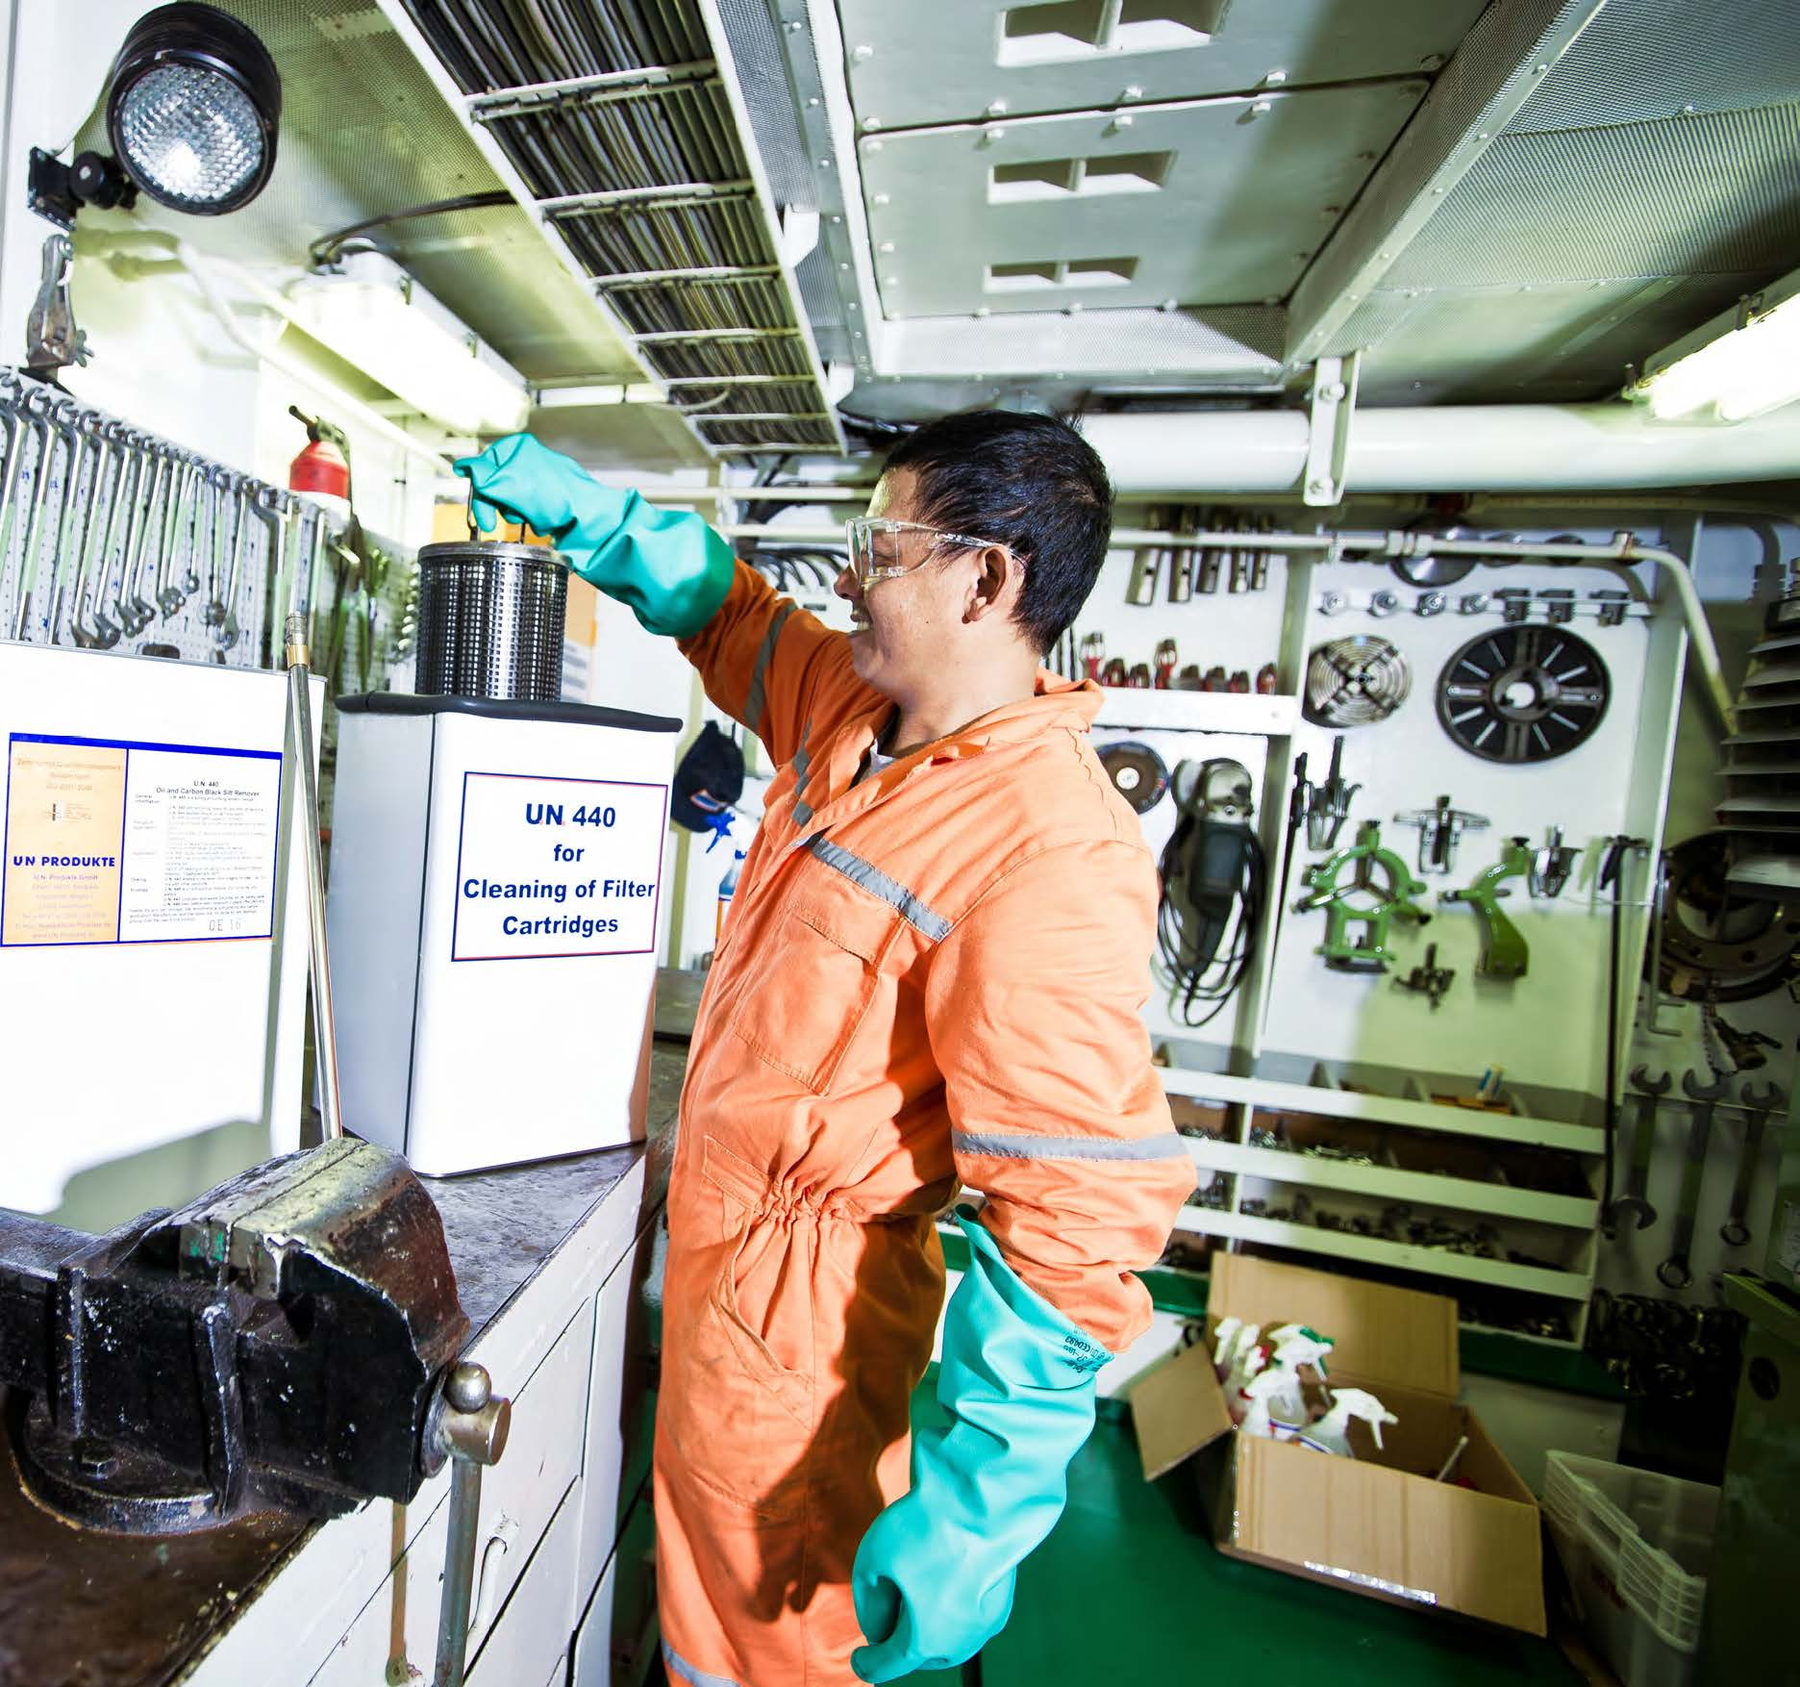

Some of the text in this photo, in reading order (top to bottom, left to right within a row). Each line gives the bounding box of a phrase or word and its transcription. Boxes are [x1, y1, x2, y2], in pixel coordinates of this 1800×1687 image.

[572, 806, 616, 828] 440
[13, 855, 116, 868] UN PRODUKTE
[553, 844, 585, 862] for
[463, 879, 656, 903] Cleaning of Filter
[503, 915, 619, 938] Cartridges
